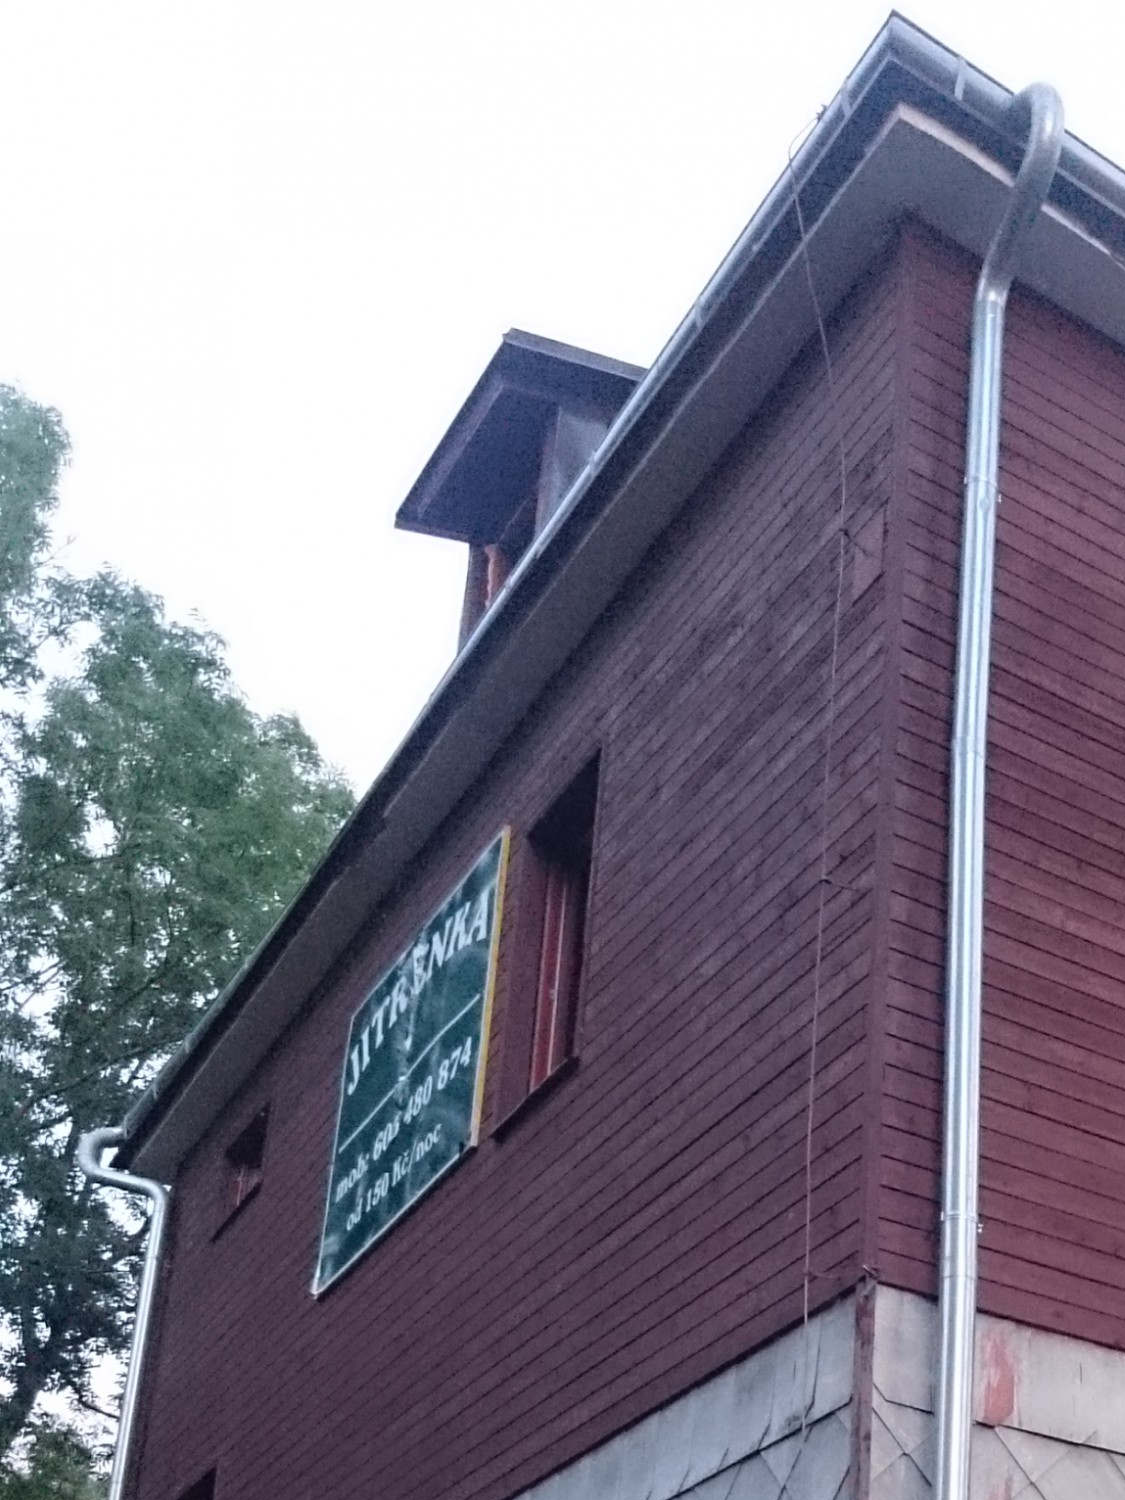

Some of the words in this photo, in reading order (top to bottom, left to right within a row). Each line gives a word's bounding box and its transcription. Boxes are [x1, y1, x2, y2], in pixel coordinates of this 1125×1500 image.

[403, 1075, 433, 1125] 480
[436, 1036, 472, 1090] 874
[346, 1197, 363, 1231] od
[365, 1172, 390, 1222] 150
